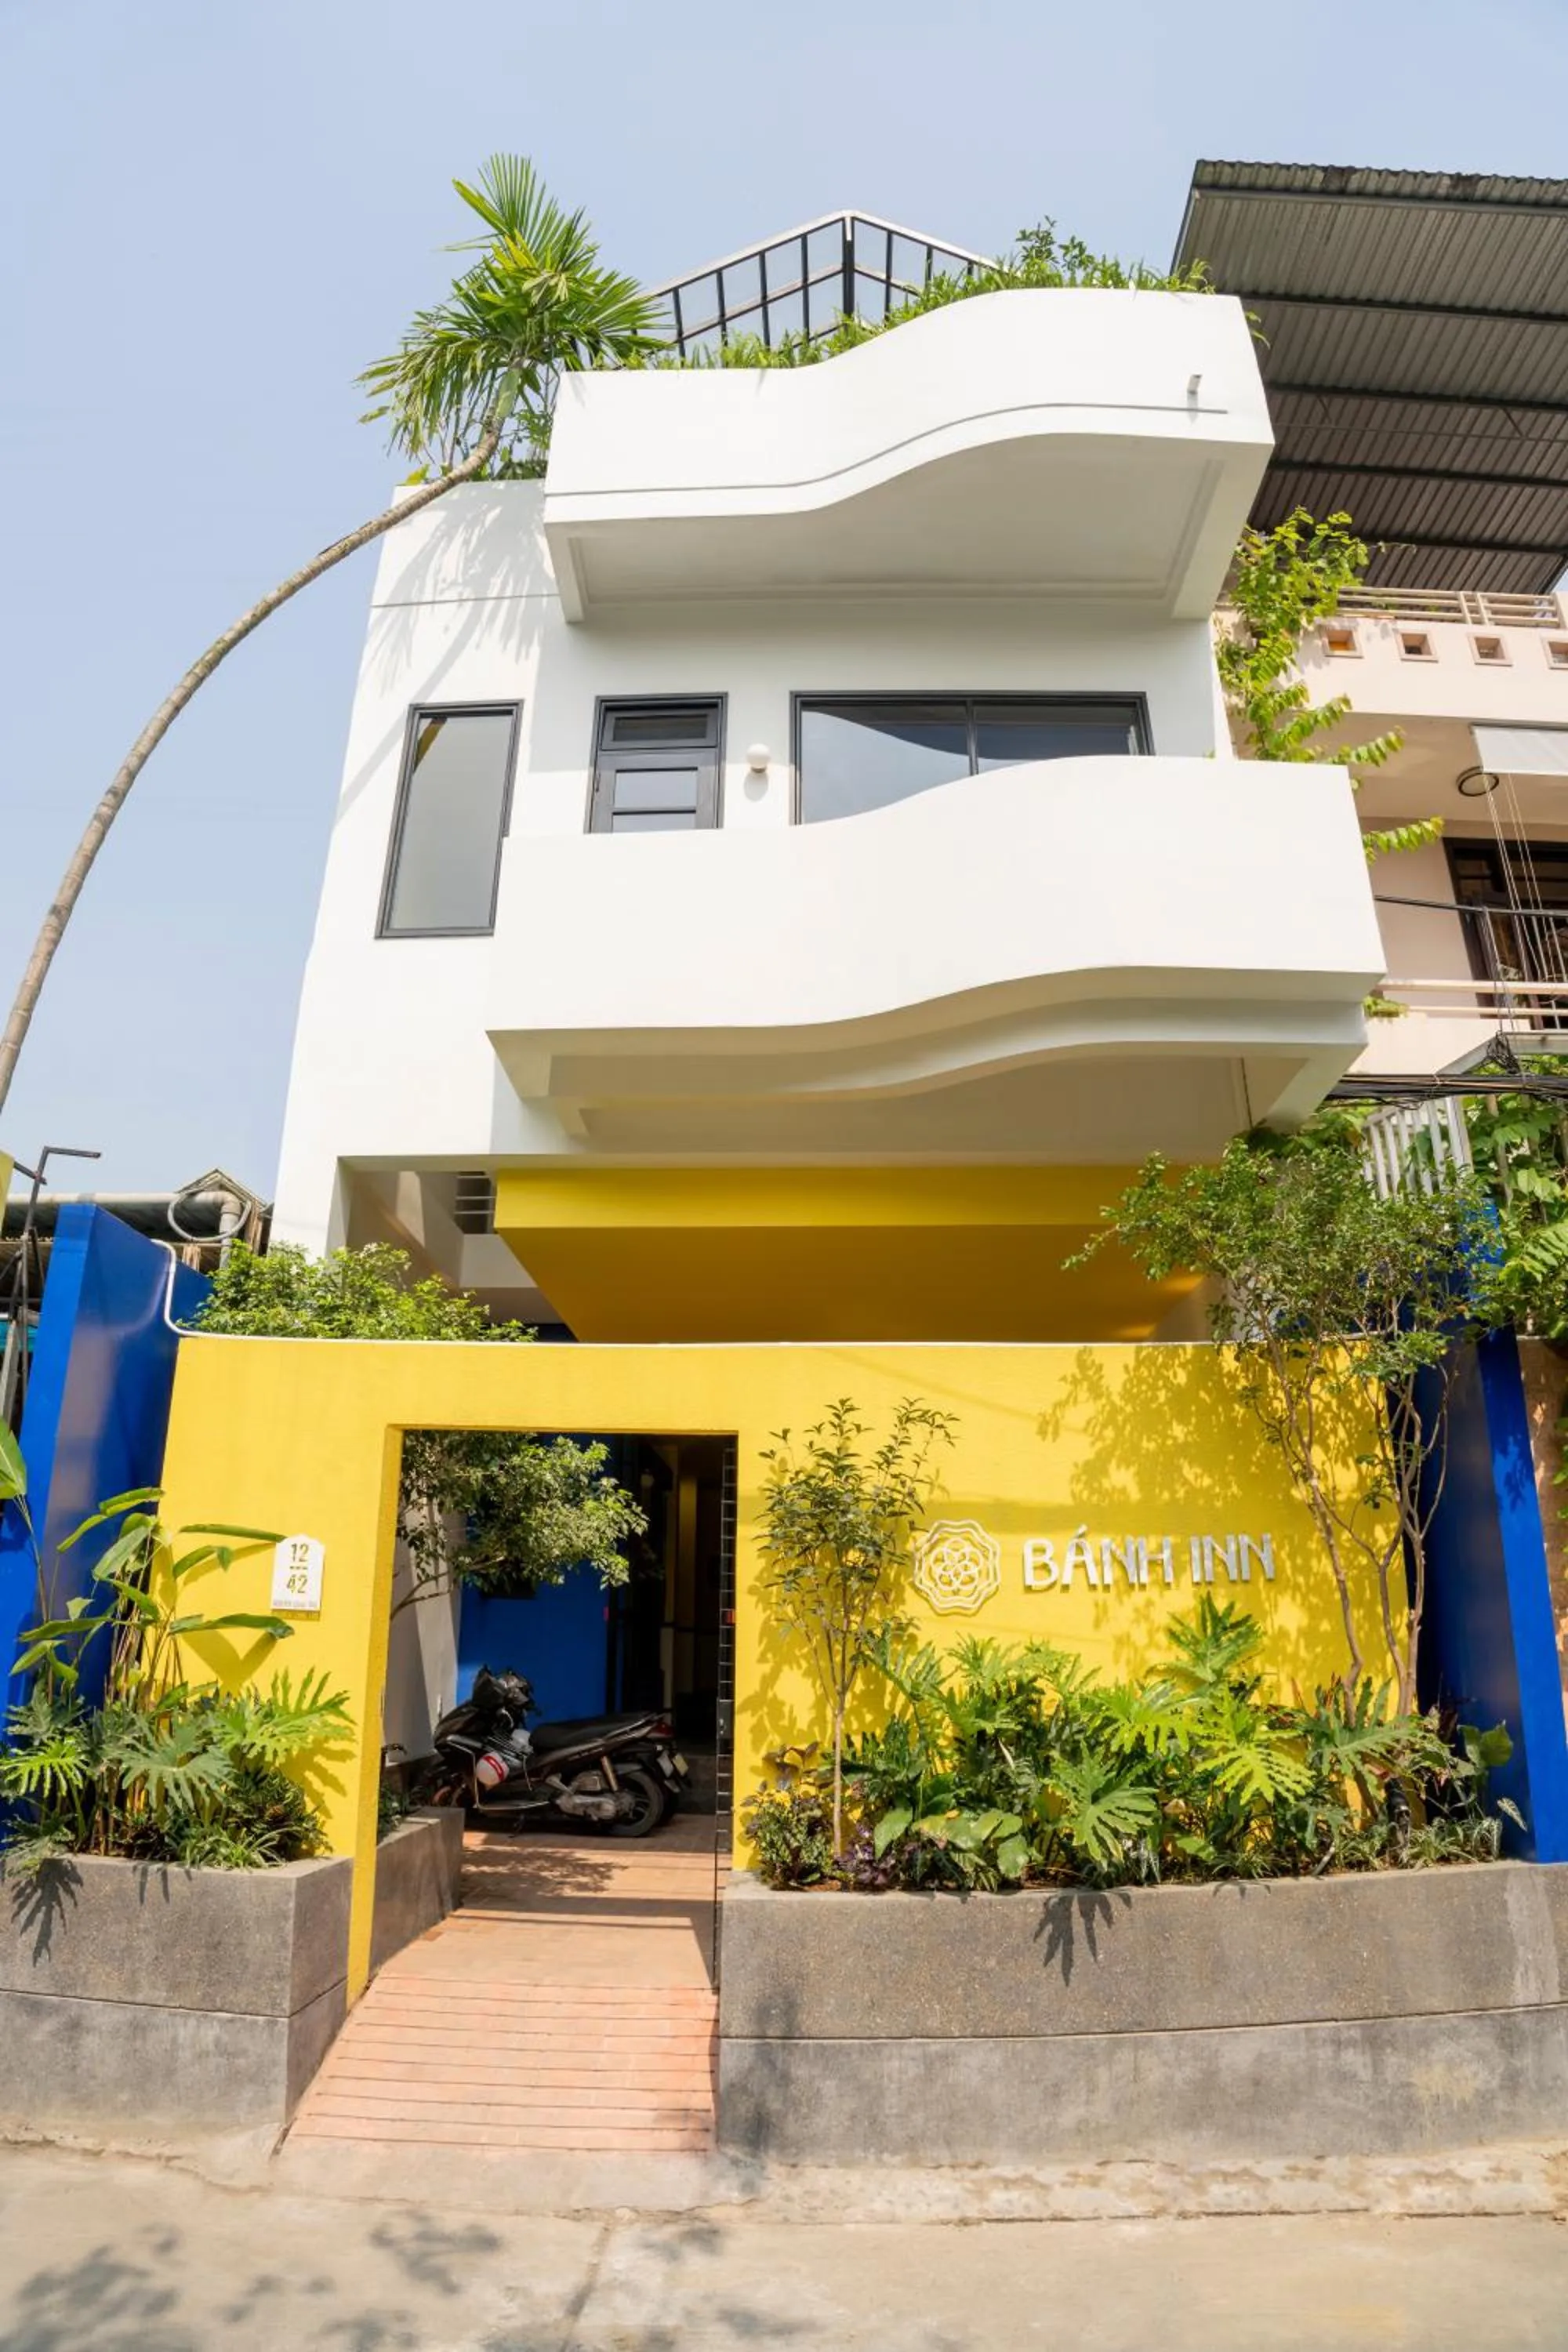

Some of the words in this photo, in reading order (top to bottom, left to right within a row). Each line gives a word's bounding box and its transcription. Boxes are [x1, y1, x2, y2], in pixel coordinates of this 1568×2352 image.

[291, 1542, 309, 1563] 12
[1022, 1524, 1173, 1588] BÁNH
[1189, 1534, 1276, 1584] INN
[286, 1573, 308, 1594] 42
